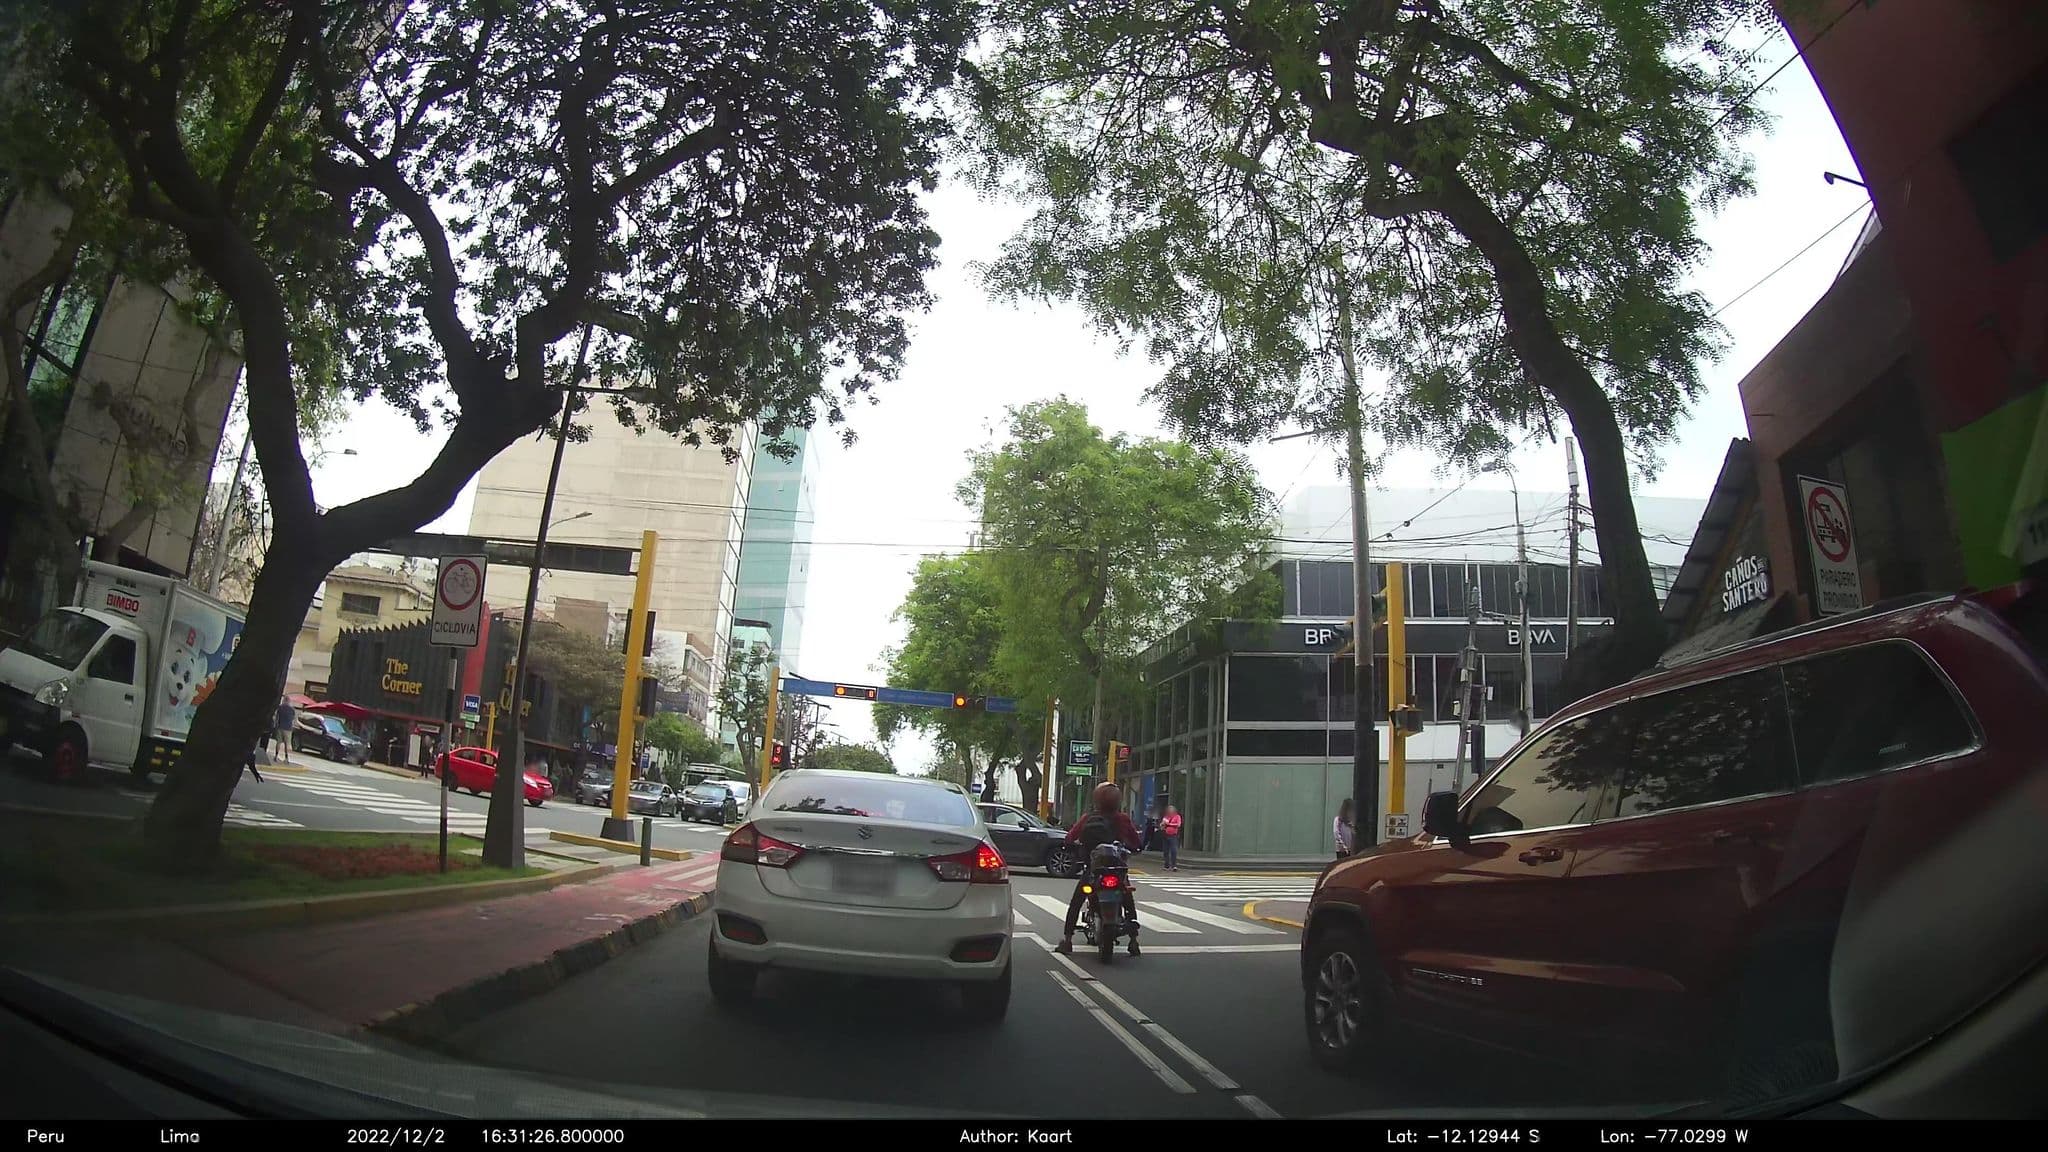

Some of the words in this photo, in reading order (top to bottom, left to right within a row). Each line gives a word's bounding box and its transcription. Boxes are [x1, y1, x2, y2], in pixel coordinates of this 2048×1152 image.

[1725, 555, 1758, 591] CAÑOS
[1722, 572, 1769, 612] SANTERO
[106, 593, 140, 612] BIMBO
[434, 622, 476, 634] CICLOVIA
[1508, 629, 1556, 645] BVA
[386, 658, 409, 675] The
[382, 674, 423, 695] Corner
